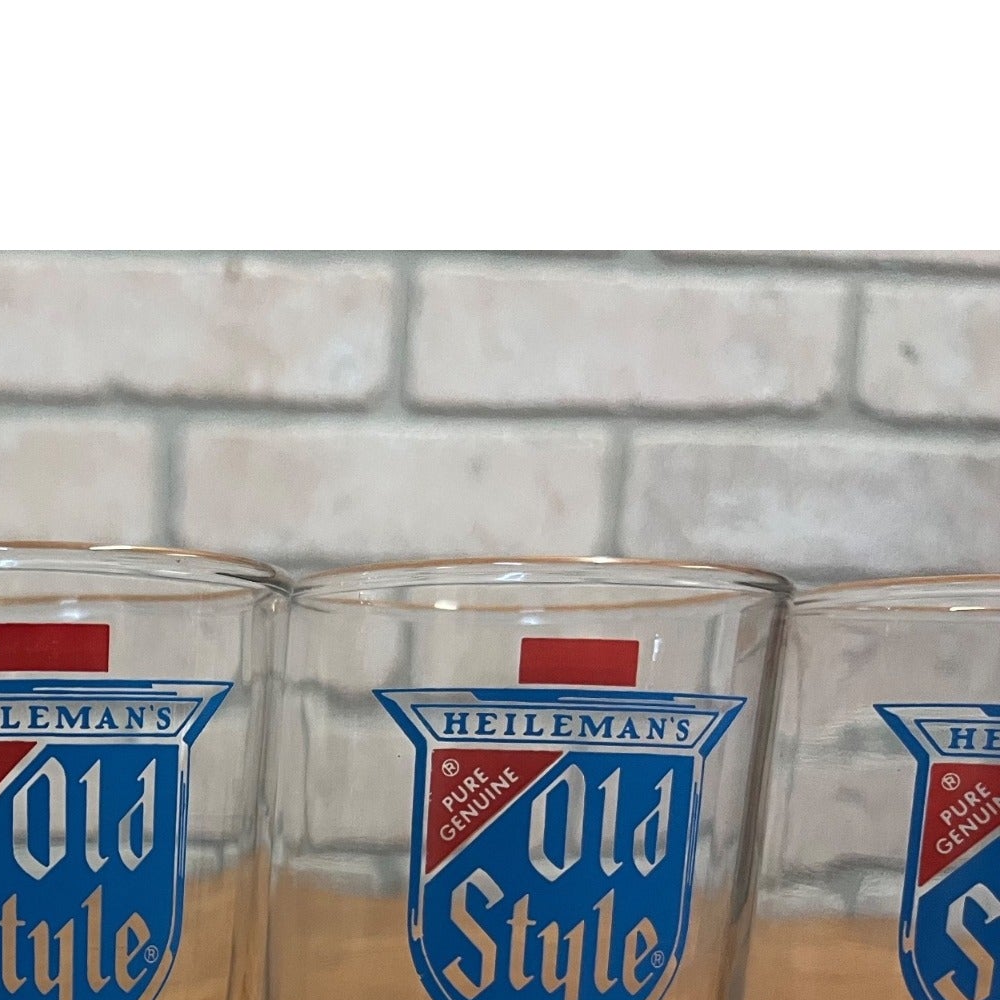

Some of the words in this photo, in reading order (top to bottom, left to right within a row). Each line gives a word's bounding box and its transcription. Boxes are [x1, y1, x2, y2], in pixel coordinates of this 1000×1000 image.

[442, 712, 690, 740] HEILEMAN'S
[12, 757, 156, 880] Old
[440, 766, 519, 842] GENUINE
[442, 767, 489, 812] PURE
[940, 782, 991, 826] PURE
[528, 763, 674, 883] Old
